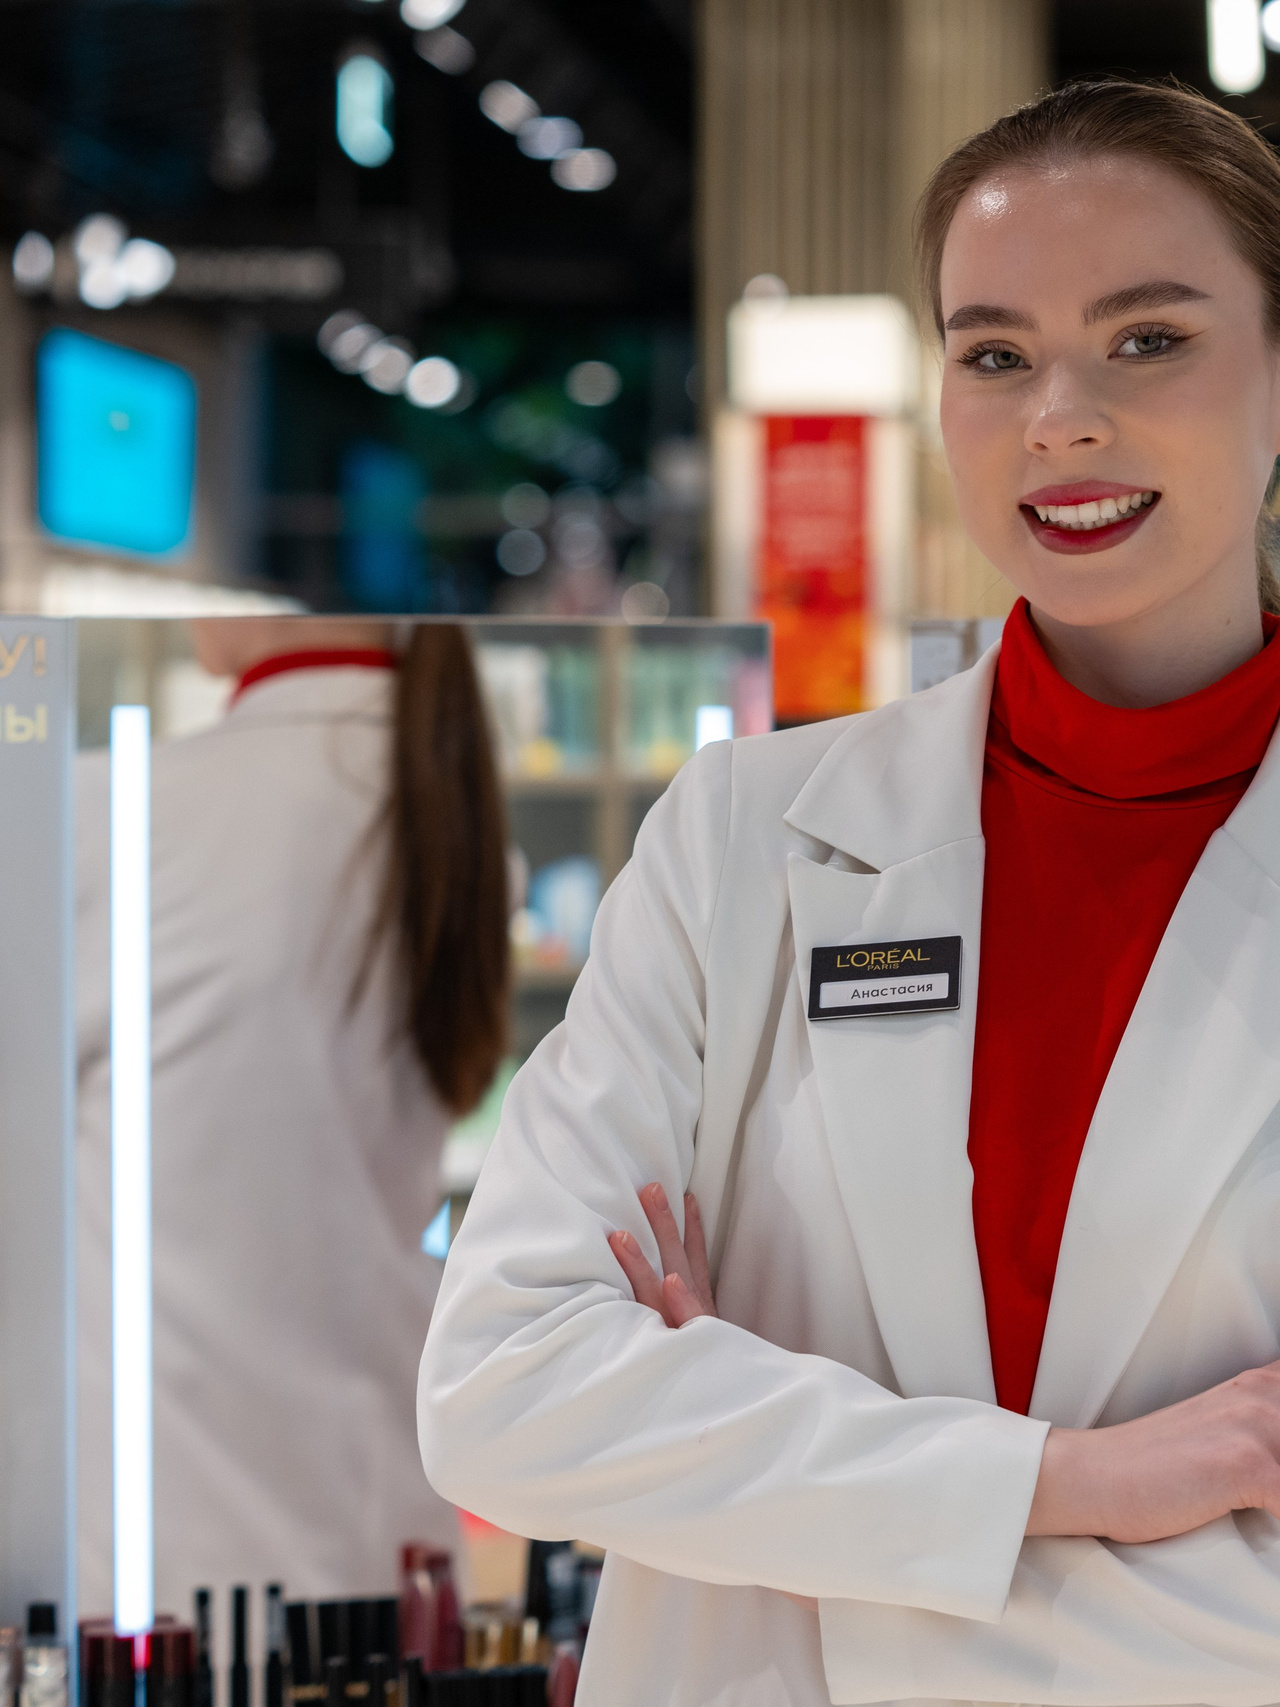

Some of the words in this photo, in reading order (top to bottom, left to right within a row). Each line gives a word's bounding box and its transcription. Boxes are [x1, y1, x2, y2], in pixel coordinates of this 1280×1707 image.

[836, 947, 931, 968] L'ORÉAL
[867, 962, 900, 972] PARIS
[850, 983, 933, 1000] Анастасия
